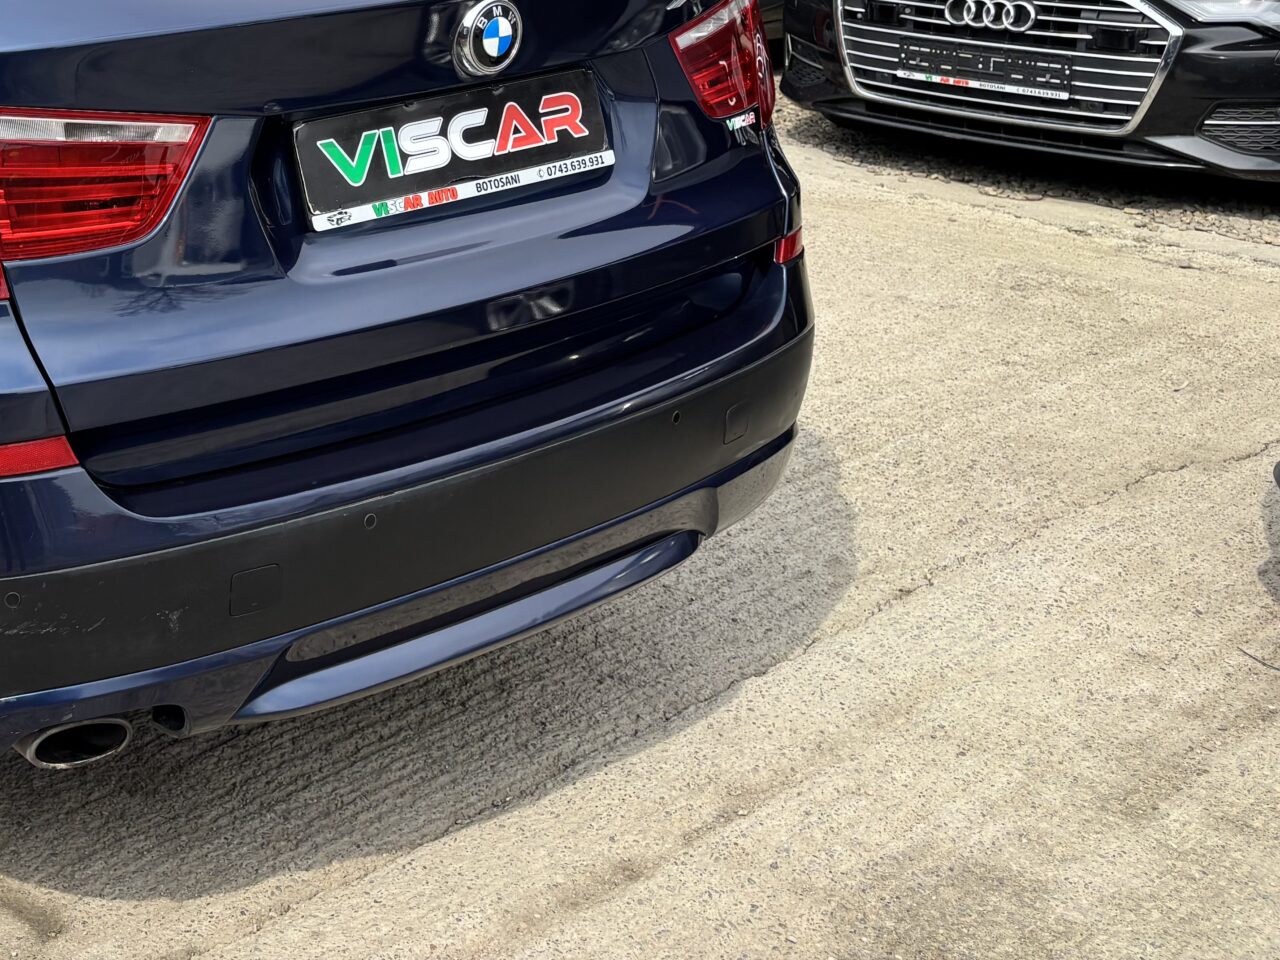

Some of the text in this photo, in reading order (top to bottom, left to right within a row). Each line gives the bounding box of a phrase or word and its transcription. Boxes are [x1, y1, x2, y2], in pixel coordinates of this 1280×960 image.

[477, 5, 516, 30] BMW
[979, 82, 1006, 91] BOTOSANI
[317, 91, 590, 187] VISCAR
[372, 155, 605, 218] VISCAR AUTO BOTOSANI 0743.639.931
